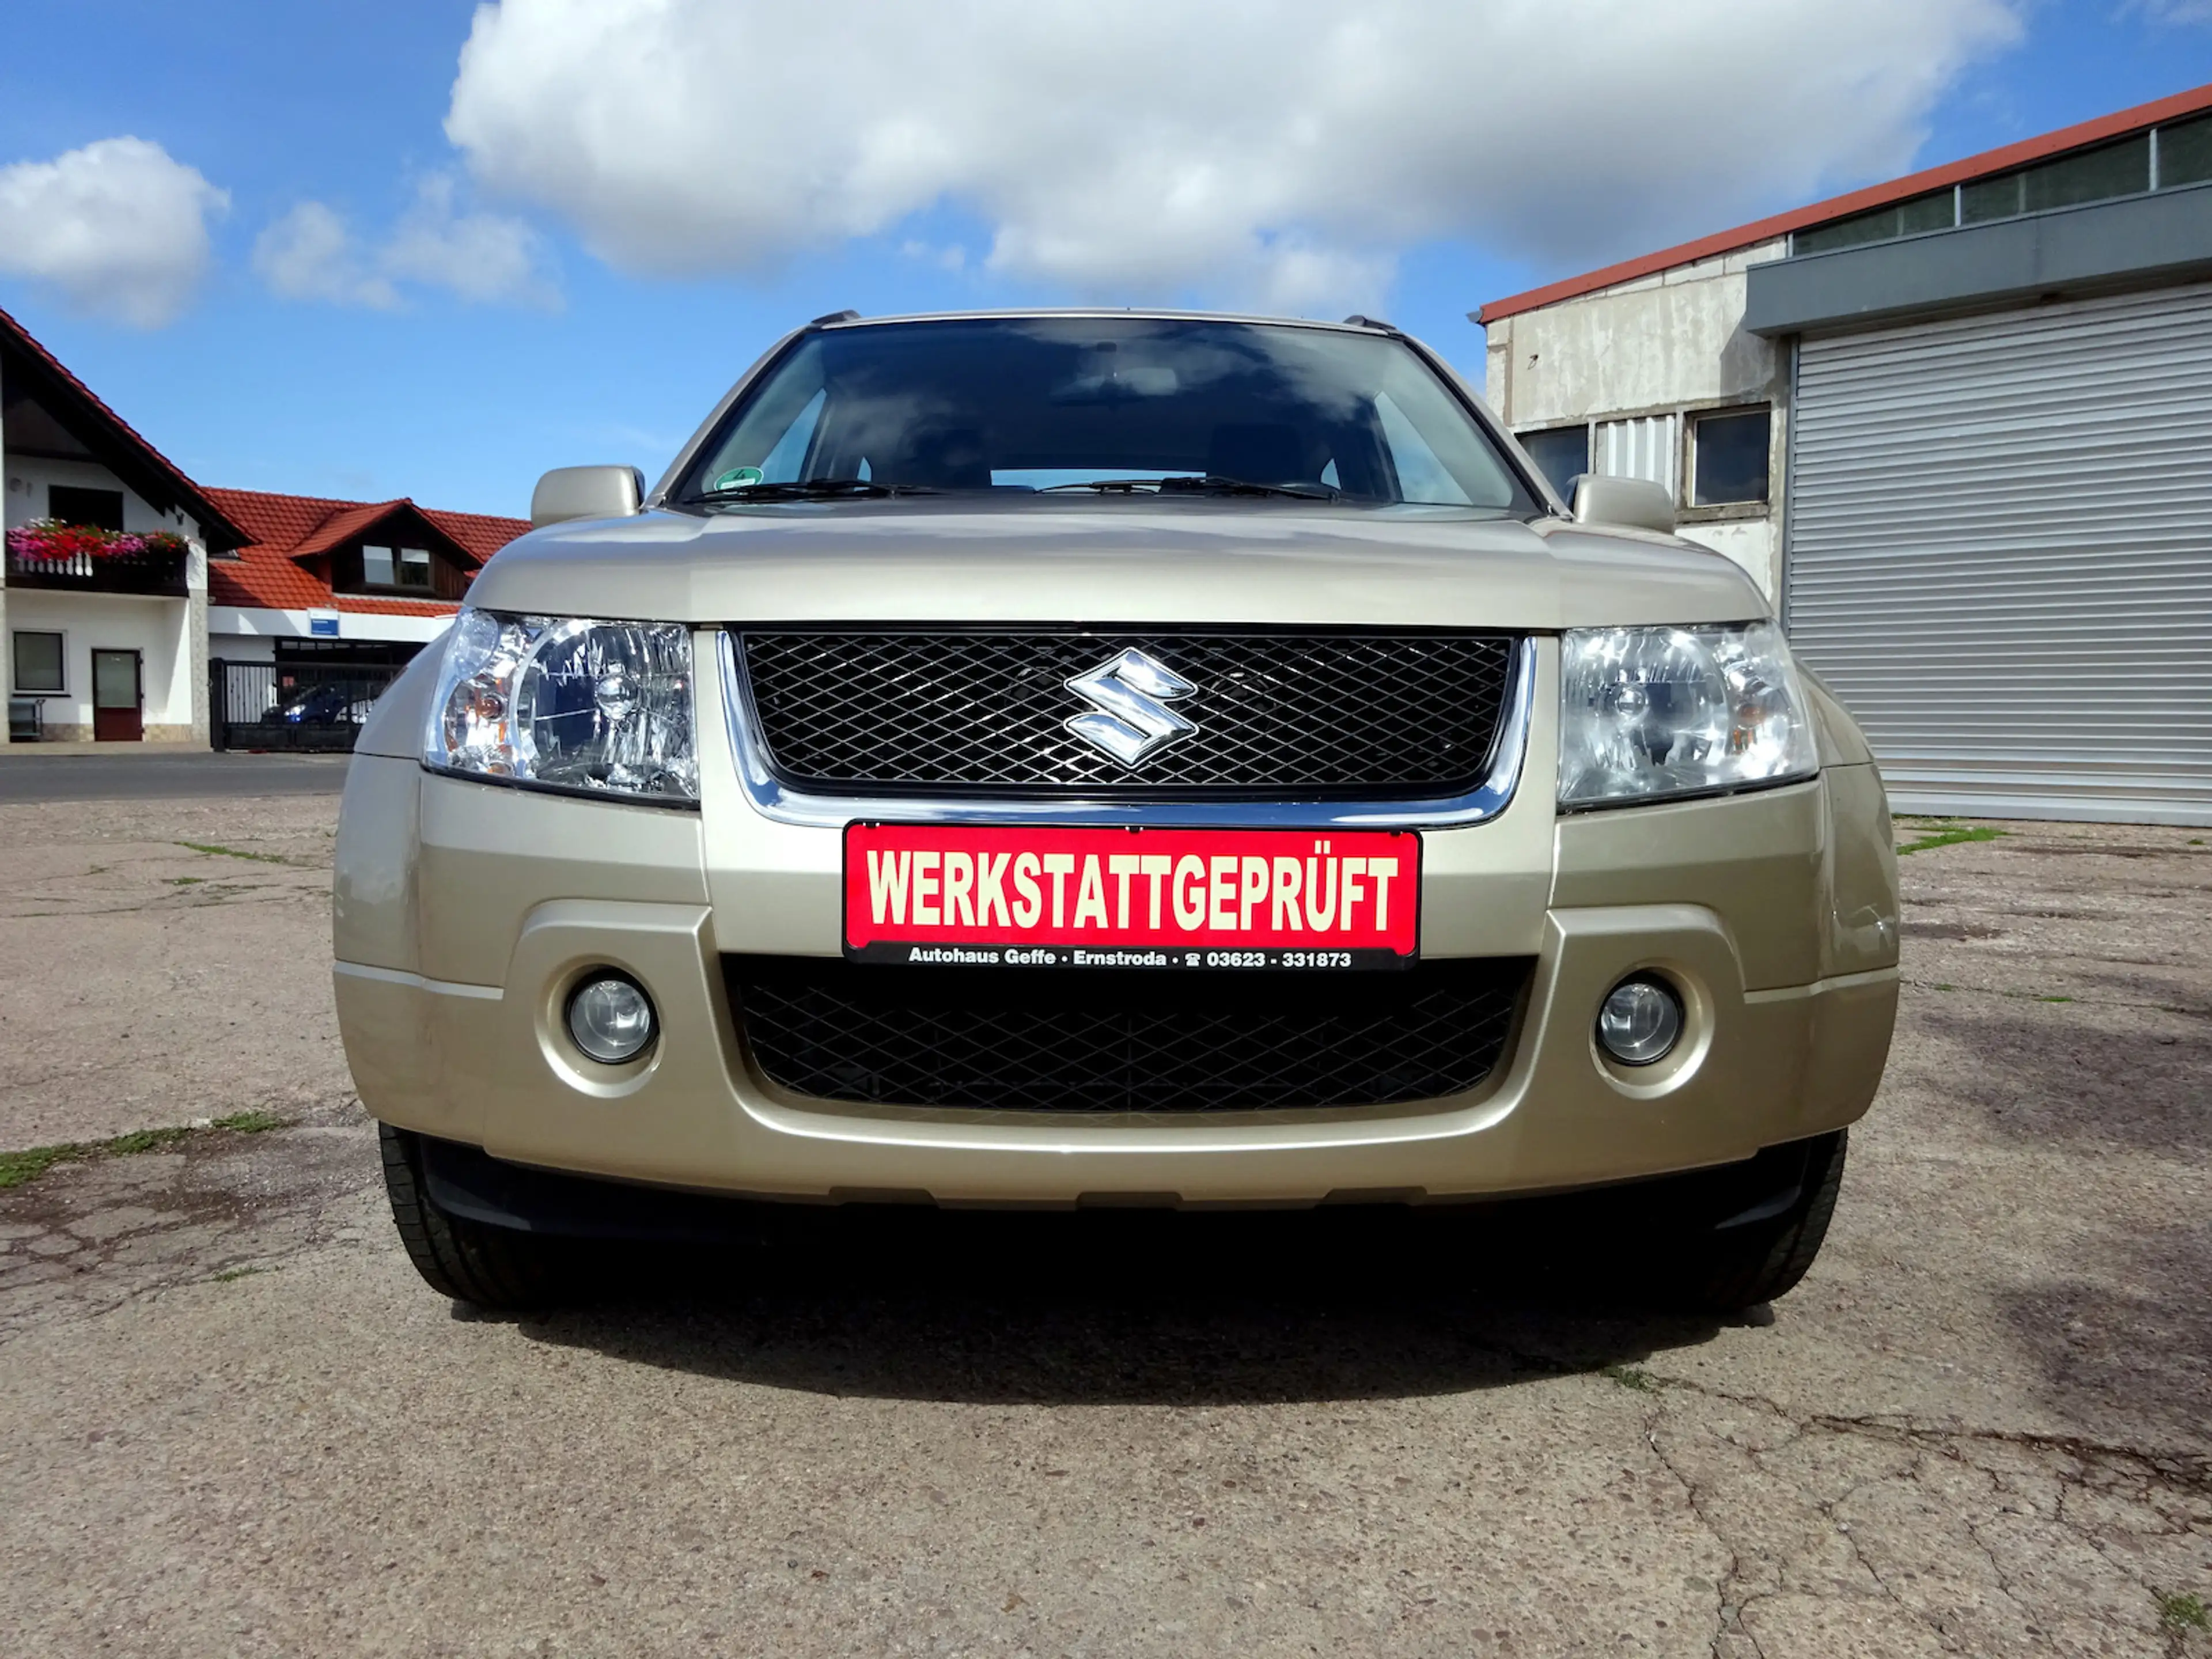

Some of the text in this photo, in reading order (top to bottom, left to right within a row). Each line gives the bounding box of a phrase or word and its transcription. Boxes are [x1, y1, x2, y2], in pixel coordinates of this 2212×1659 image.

[866, 840, 1399, 932] WERKSTATTGEPRÜFT
[908, 946, 999, 964] Autohaus
[1004, 948, 1056, 964] Geffe
[1073, 950, 1167, 966] Ernstroda
[1207, 952, 1266, 967] 03623
[1282, 952, 1351, 967] 331873
